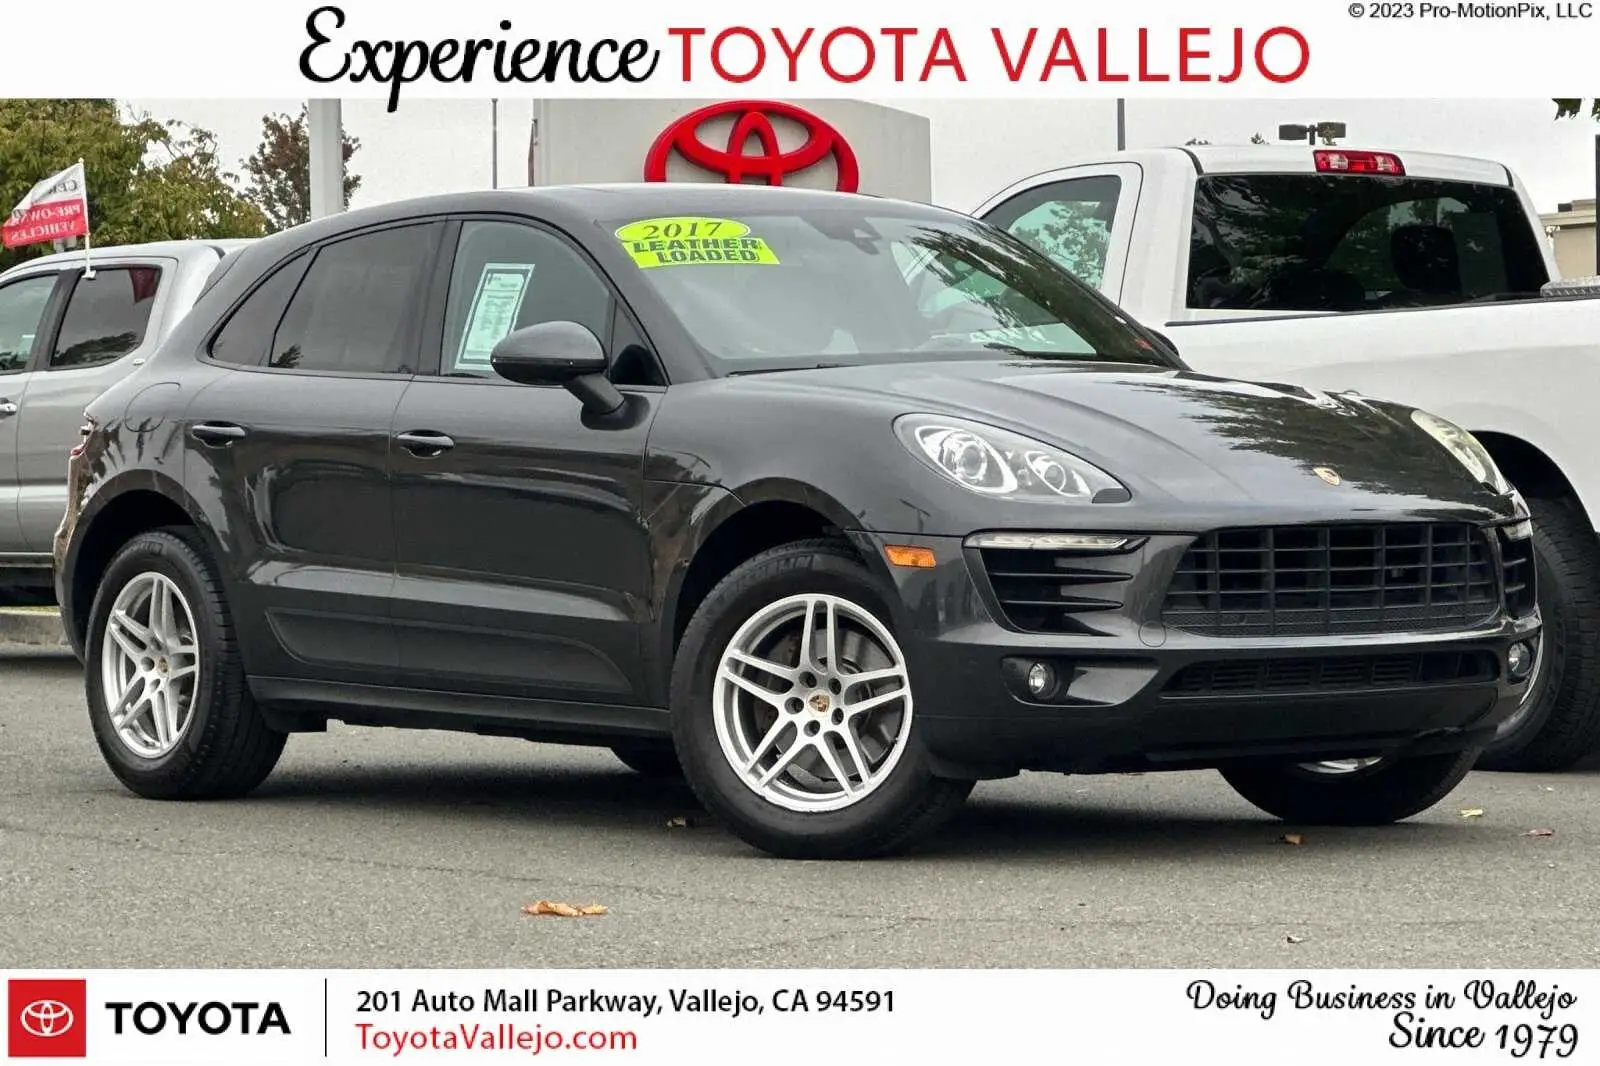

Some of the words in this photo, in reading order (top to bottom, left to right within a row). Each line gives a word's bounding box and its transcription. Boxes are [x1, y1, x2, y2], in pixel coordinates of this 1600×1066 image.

[641, 221, 723, 240] 2017
[632, 238, 760, 253] LEATHER
[656, 249, 760, 263] LOADED
